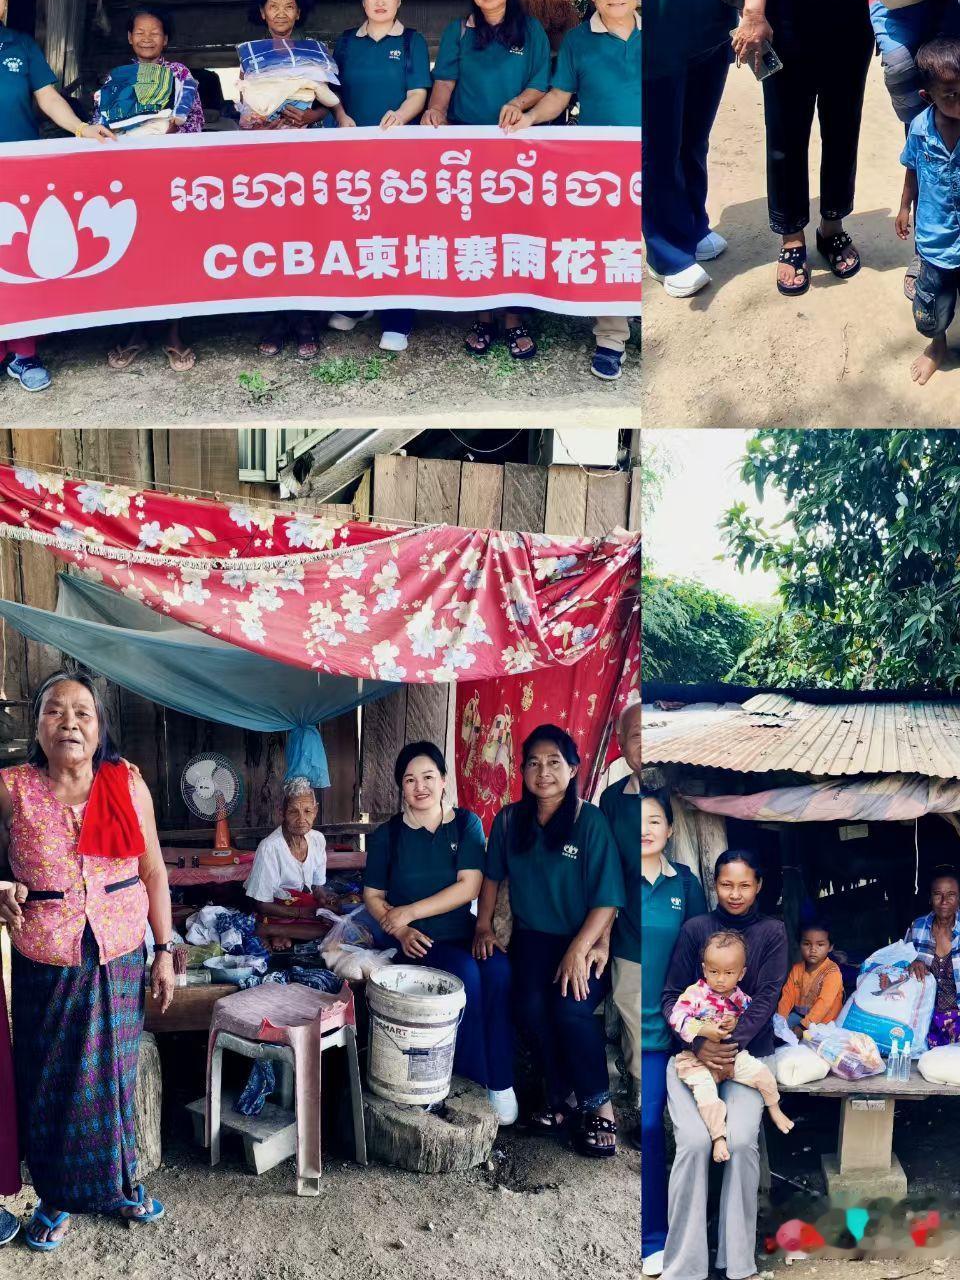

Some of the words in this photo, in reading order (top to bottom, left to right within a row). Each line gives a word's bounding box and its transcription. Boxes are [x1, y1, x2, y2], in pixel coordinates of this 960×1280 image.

[170, 149, 641, 222] អាហារបួសអ៊ីហ័រចា
